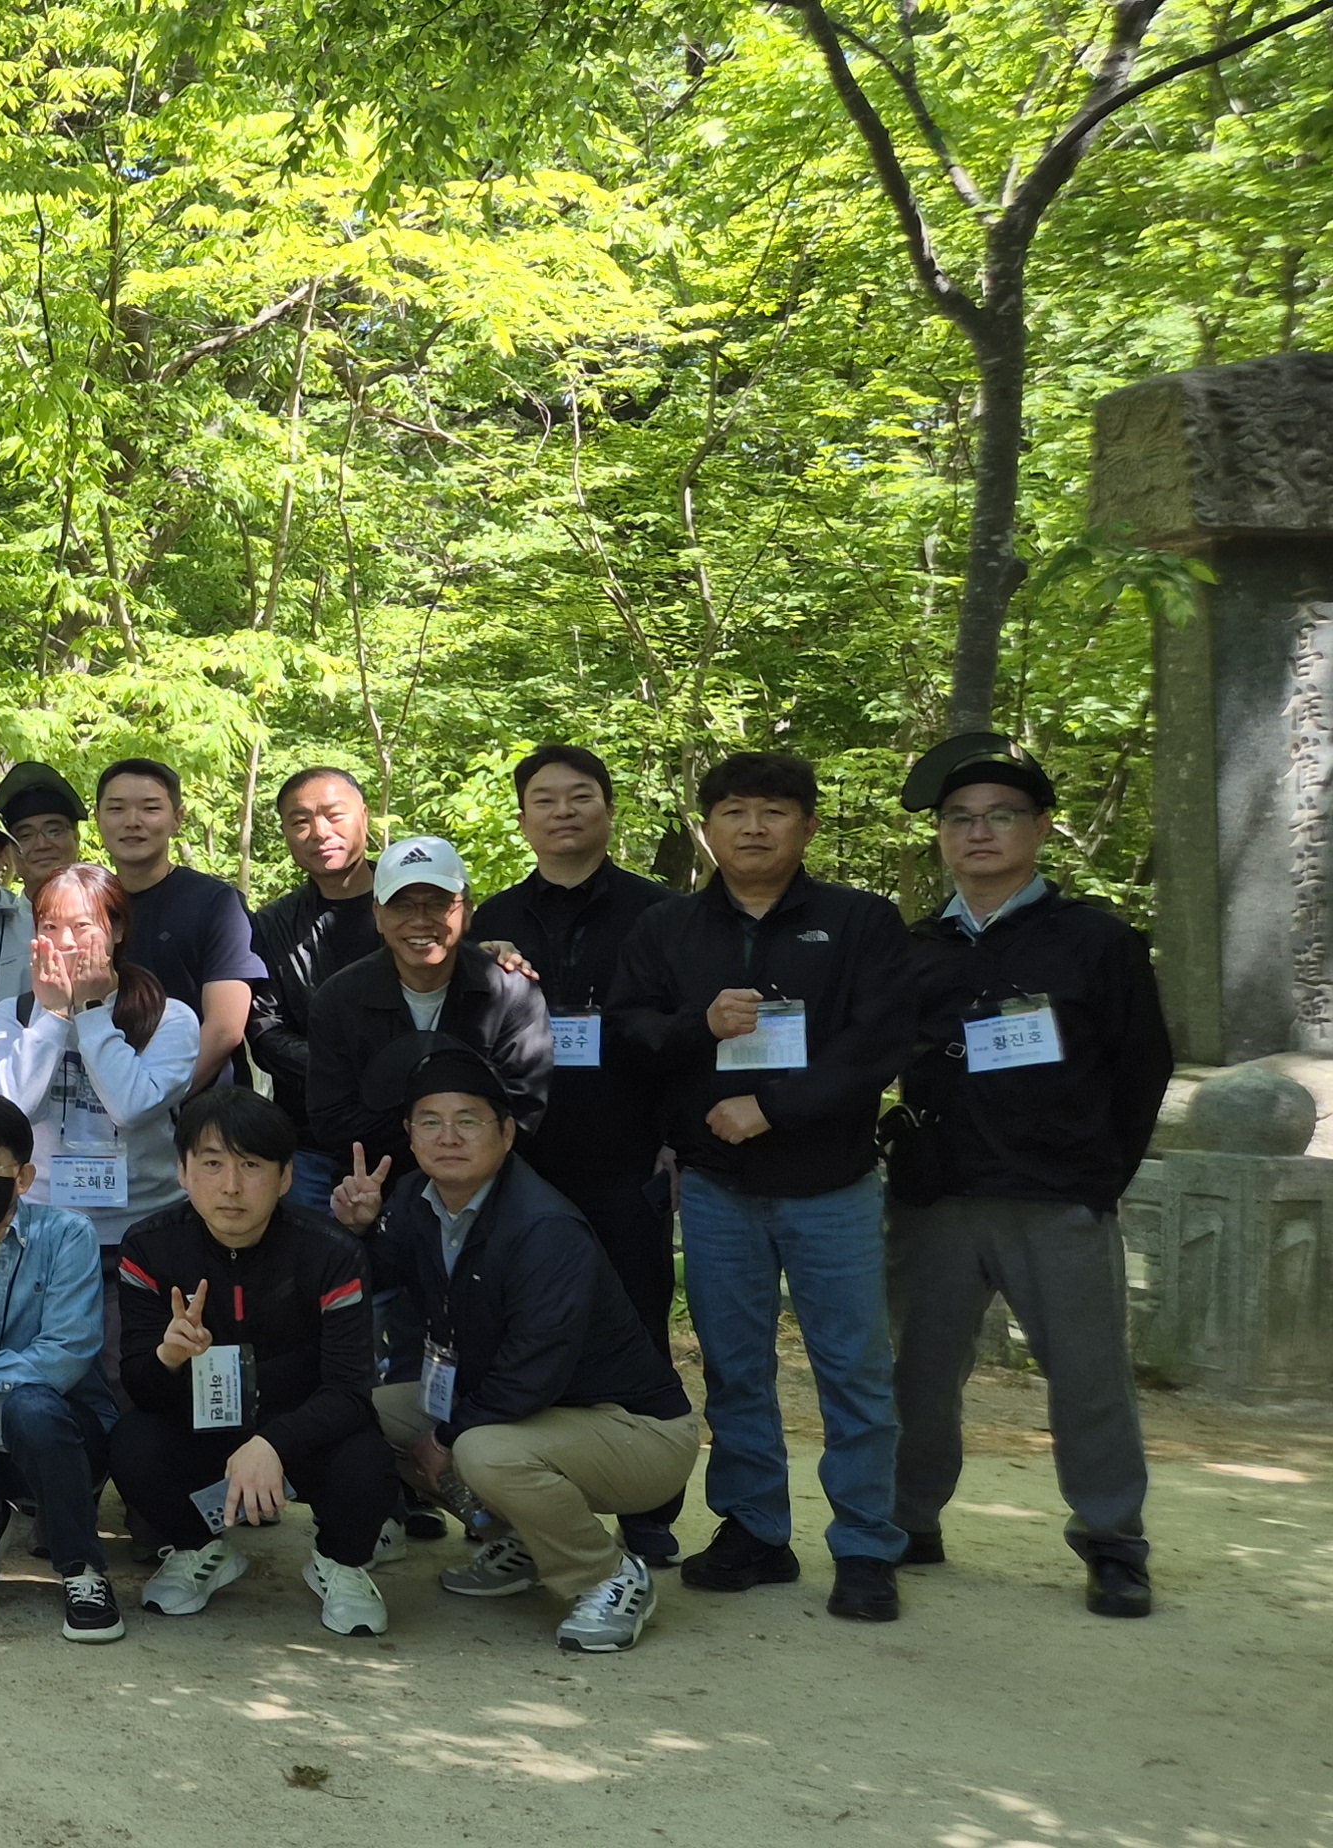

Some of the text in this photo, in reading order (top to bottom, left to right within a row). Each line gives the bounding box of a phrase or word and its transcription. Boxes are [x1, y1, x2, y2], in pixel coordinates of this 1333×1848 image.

[400, 856, 432, 867] adidas
[992, 1031, 1044, 1050] 황진호
[73, 1175, 116, 1190] 조혜원
